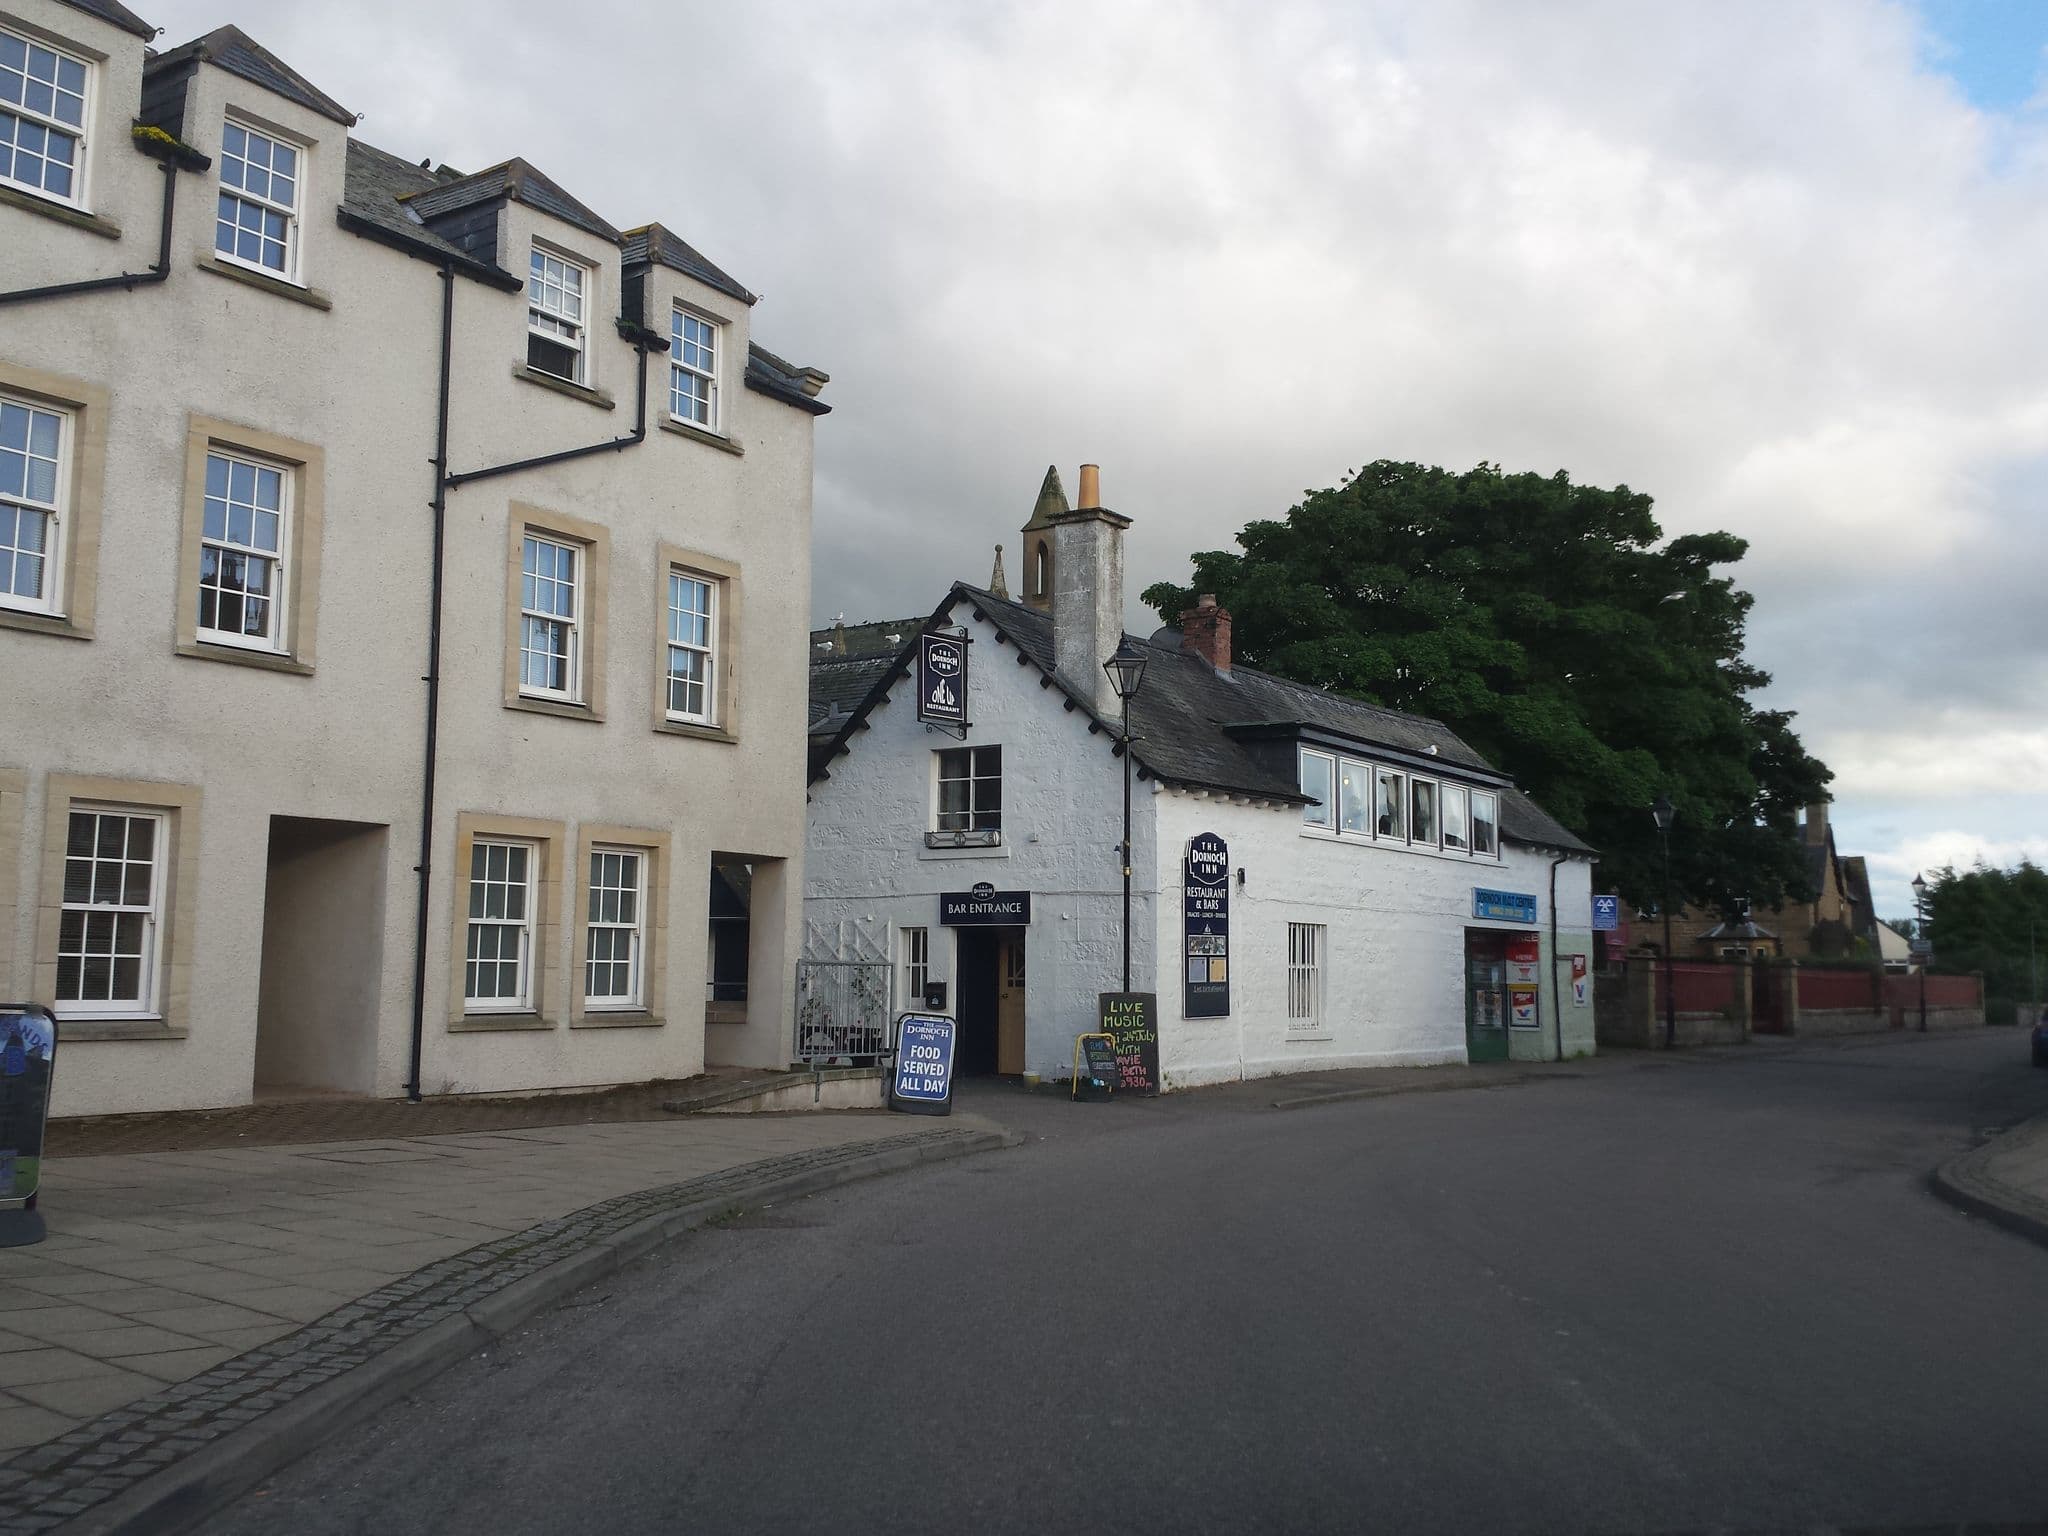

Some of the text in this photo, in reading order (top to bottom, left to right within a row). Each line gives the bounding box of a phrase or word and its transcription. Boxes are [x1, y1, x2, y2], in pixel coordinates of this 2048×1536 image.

[931, 653, 958, 667] DORNOCH
[938, 662, 951, 671] INN
[931, 678, 955, 706] ONE UP
[926, 703, 960, 714] RESTAURANT
[1202, 842, 1217, 852] THE
[1192, 849, 1226, 866] DORNOCH
[1202, 863, 1217, 874] INN
[1187, 886, 1227, 899] RESTAURANT
[948, 902, 1022, 914] BAR ENTRANCE
[1195, 899, 1219, 910] & BARS
[1110, 1000, 1143, 1013] LIVE
[1103, 1014, 1145, 1028] MUSIC
[907, 1025, 949, 1038] DORNOCH
[919, 1033, 936, 1041] INN
[910, 1045, 941, 1060] FOOD
[903, 1060, 945, 1076] SERVED
[901, 1077, 945, 1093] ALL DAY
